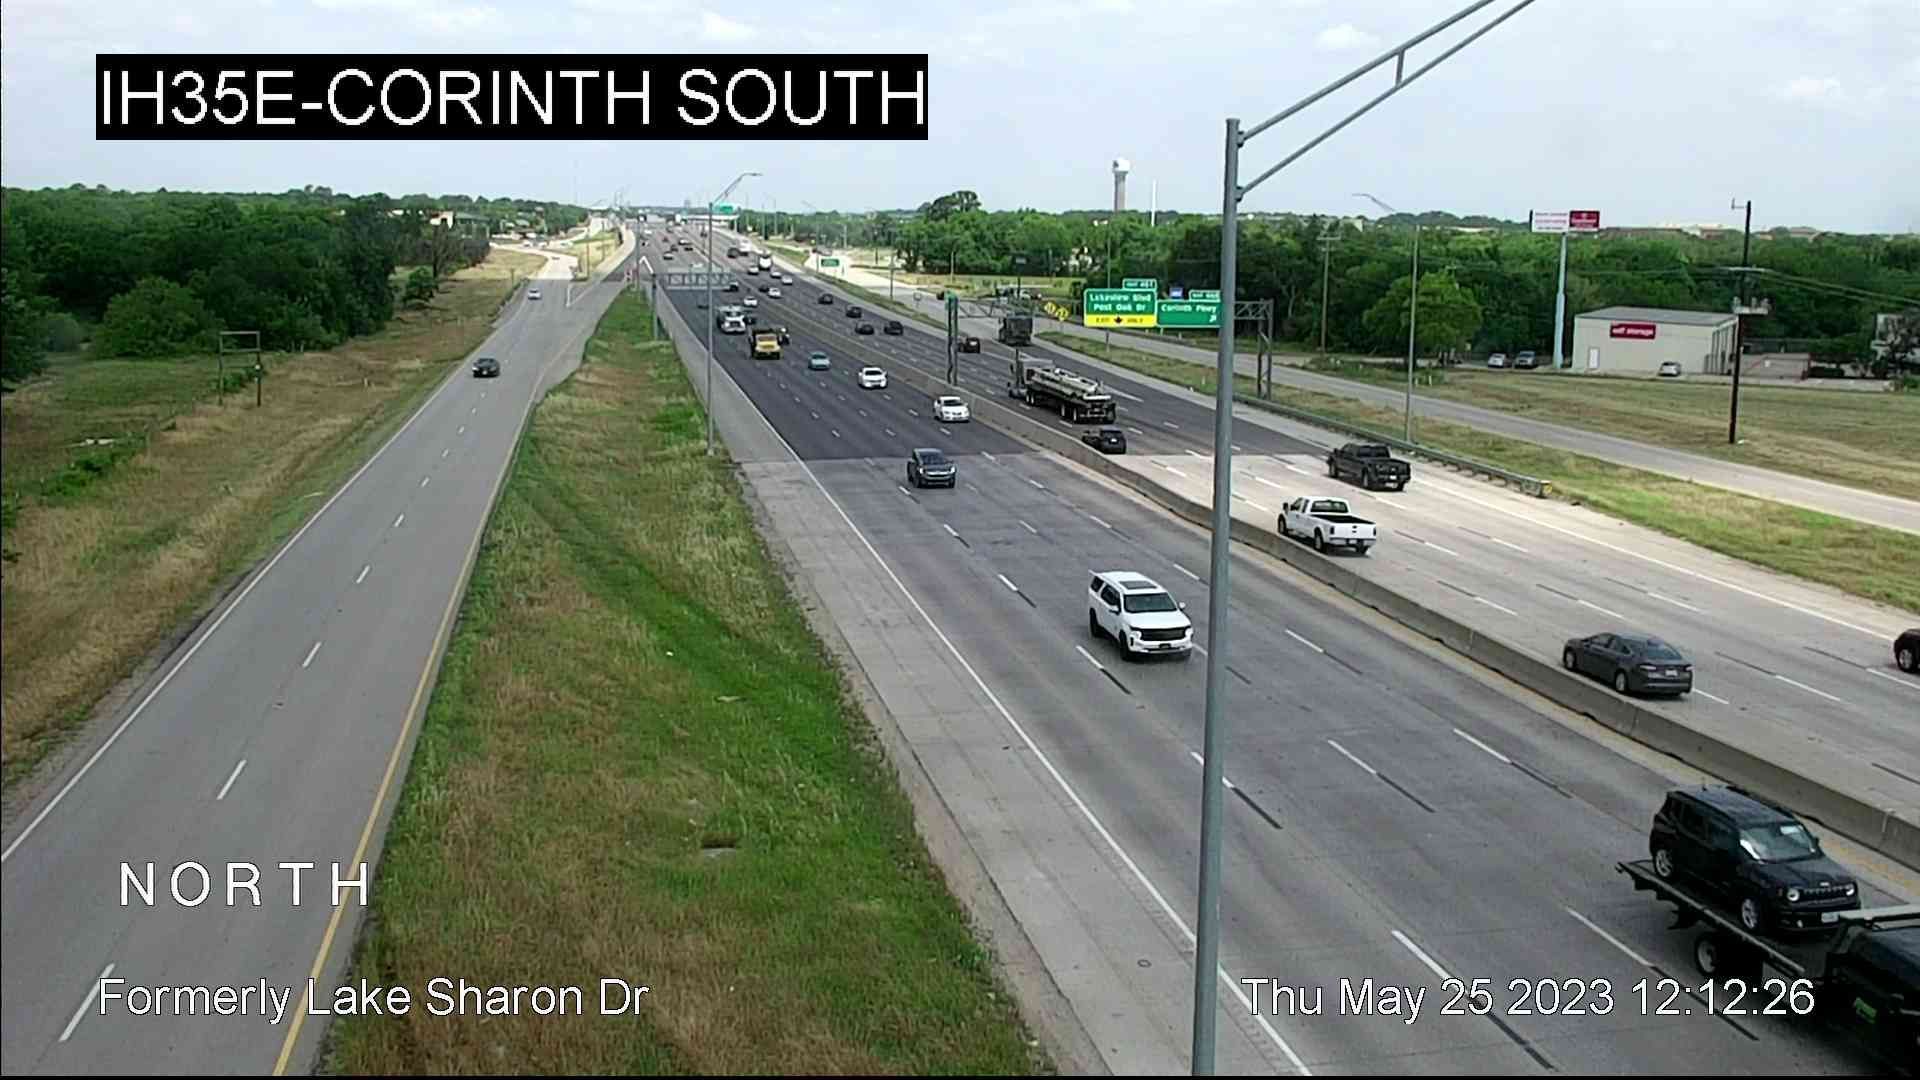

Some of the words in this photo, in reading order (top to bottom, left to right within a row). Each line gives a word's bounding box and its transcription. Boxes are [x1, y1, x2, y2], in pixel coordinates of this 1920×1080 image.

[1132, 293, 1152, 302] Blvd
[1093, 303, 1112, 312] Post
[1116, 303, 1132, 312] Oak
[1135, 303, 1146, 312] Dr
